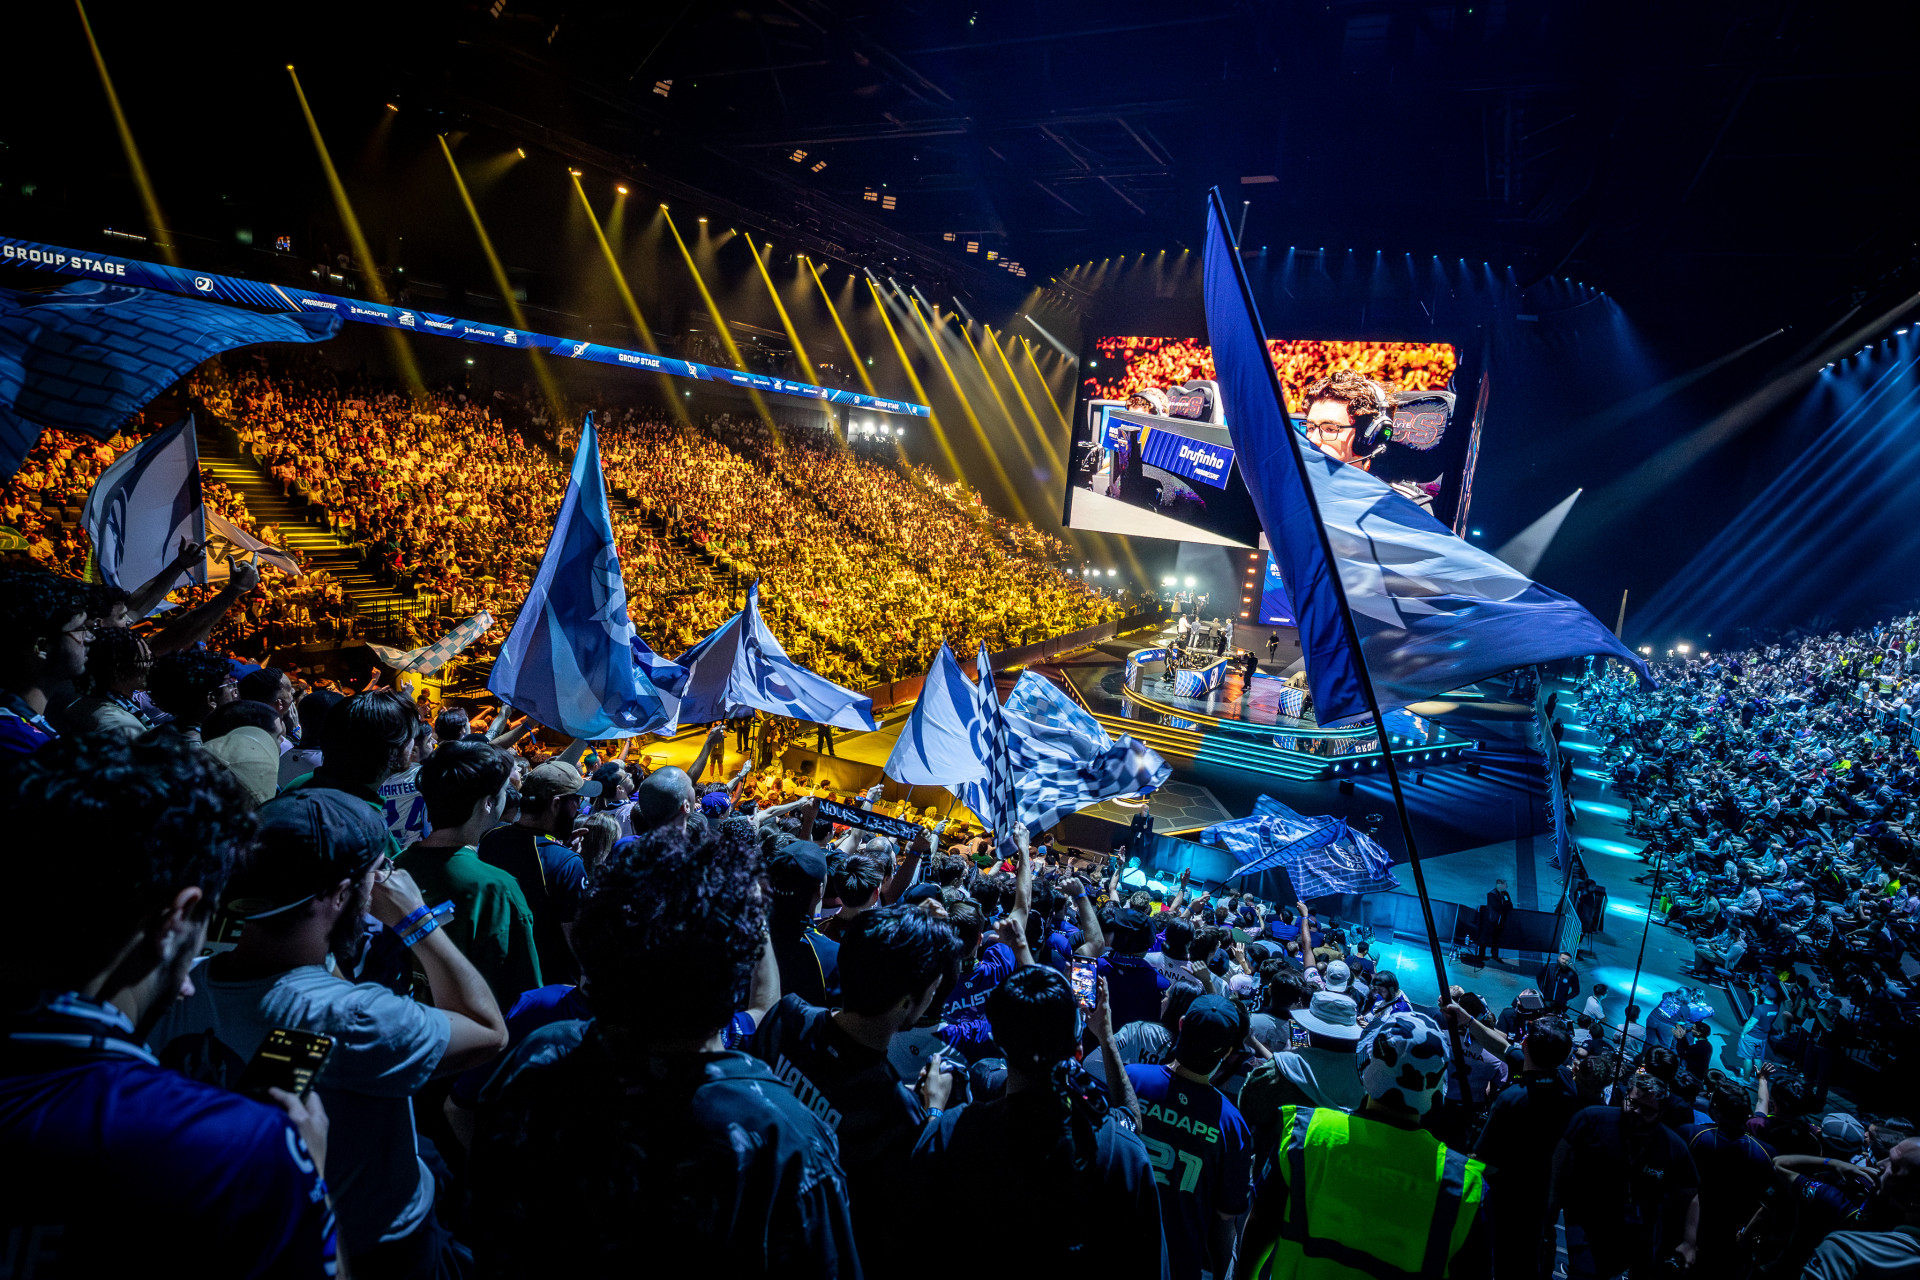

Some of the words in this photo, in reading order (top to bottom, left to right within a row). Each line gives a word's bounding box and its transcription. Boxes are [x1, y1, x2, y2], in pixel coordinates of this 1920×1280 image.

[3, 245, 66, 266] GROUP
[71, 257, 126, 276] STAGE
[302, 298, 338, 310] PROGRESSIVE
[357, 308, 389, 319] BLACKLYTE
[424, 319, 455, 330] PROGRESSIVE
[618, 353, 641, 365] GROUP
[641, 356, 660, 368] STAGE
[1179, 445, 1225, 470] Drufinho
[1140, 1134, 1204, 1194] 21
